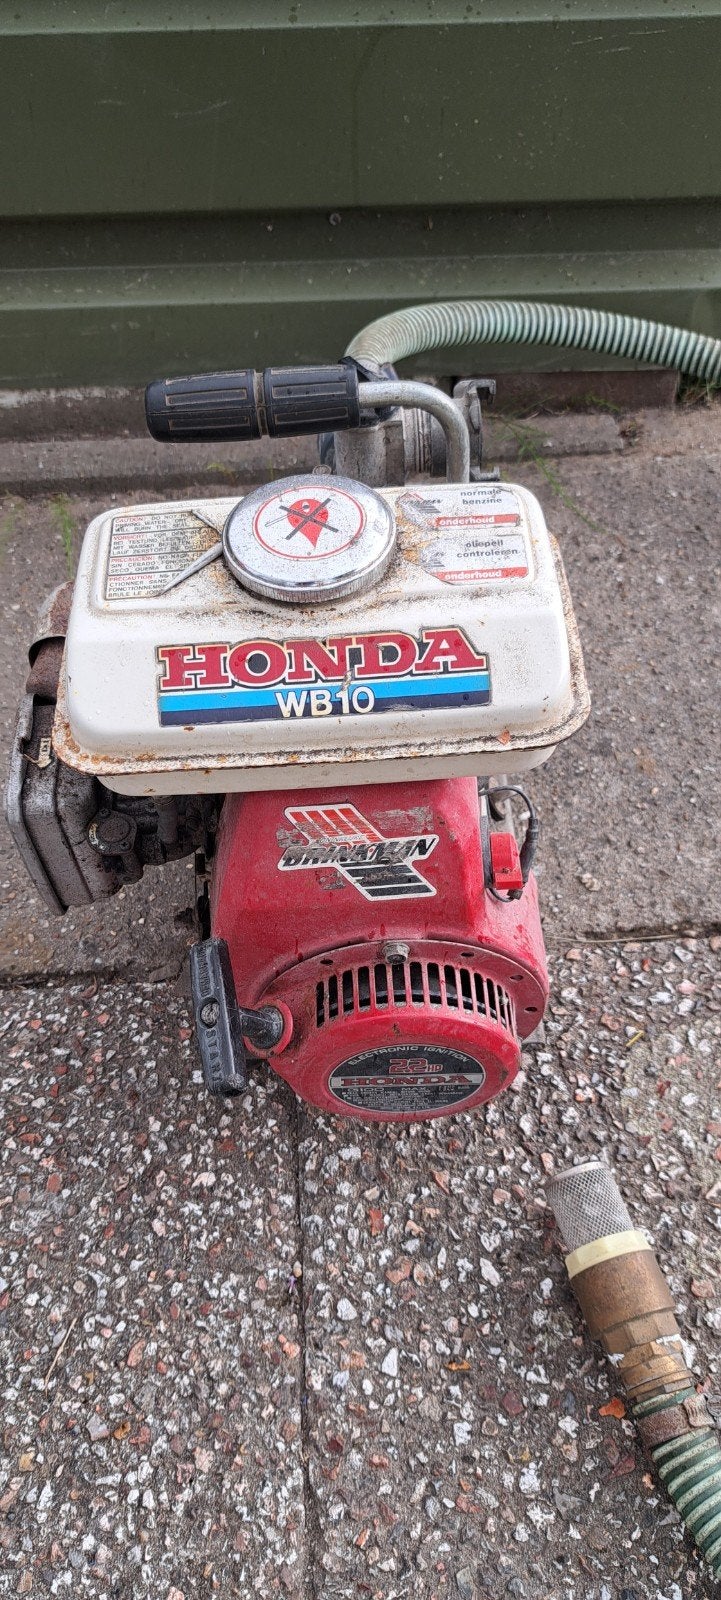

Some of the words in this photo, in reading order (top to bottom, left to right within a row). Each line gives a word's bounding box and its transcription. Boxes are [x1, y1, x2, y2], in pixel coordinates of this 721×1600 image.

[460, 489, 502, 497] normale
[438, 516, 495, 526] onderhoud
[456, 549, 519, 558] controleren
[444, 570, 502, 580] onderhoud
[159, 627, 487, 690] HONDA
[275, 686, 375, 718] WB10
[204, 1028, 223, 1083] START
[348, 1045, 419, 1066] ELECTRONIC
[423, 1046, 471, 1063] IGNITION
[340, 1075, 473, 1087] HONDA
